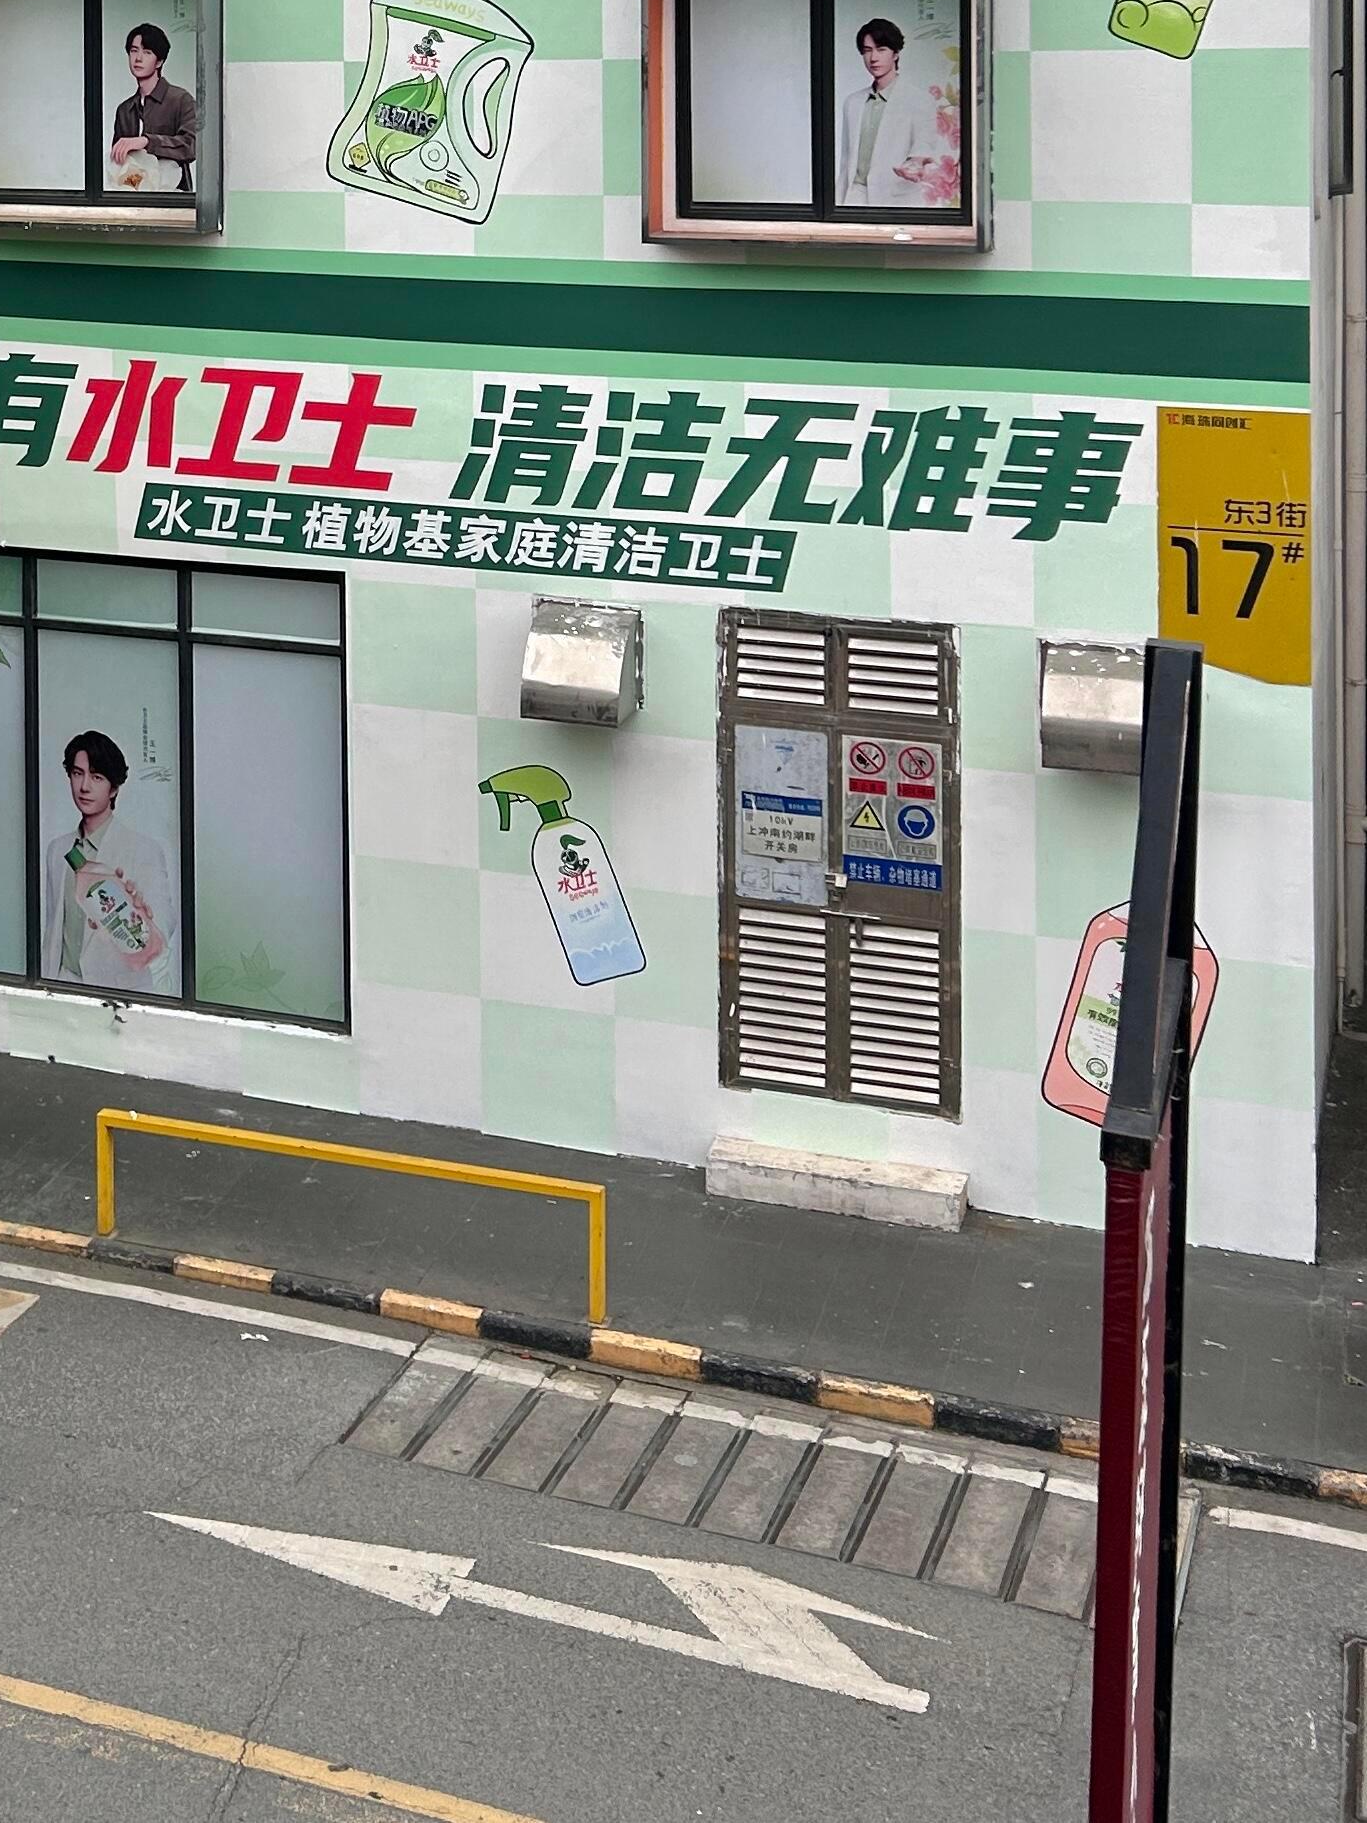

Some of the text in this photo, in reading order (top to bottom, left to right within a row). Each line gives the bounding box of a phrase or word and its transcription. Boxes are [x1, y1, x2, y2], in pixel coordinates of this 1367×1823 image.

[449, 383, 1145, 542] 清洁无难事
[1223, 499, 1307, 529] 东3街
[557, 869, 597, 894] 水卫士
